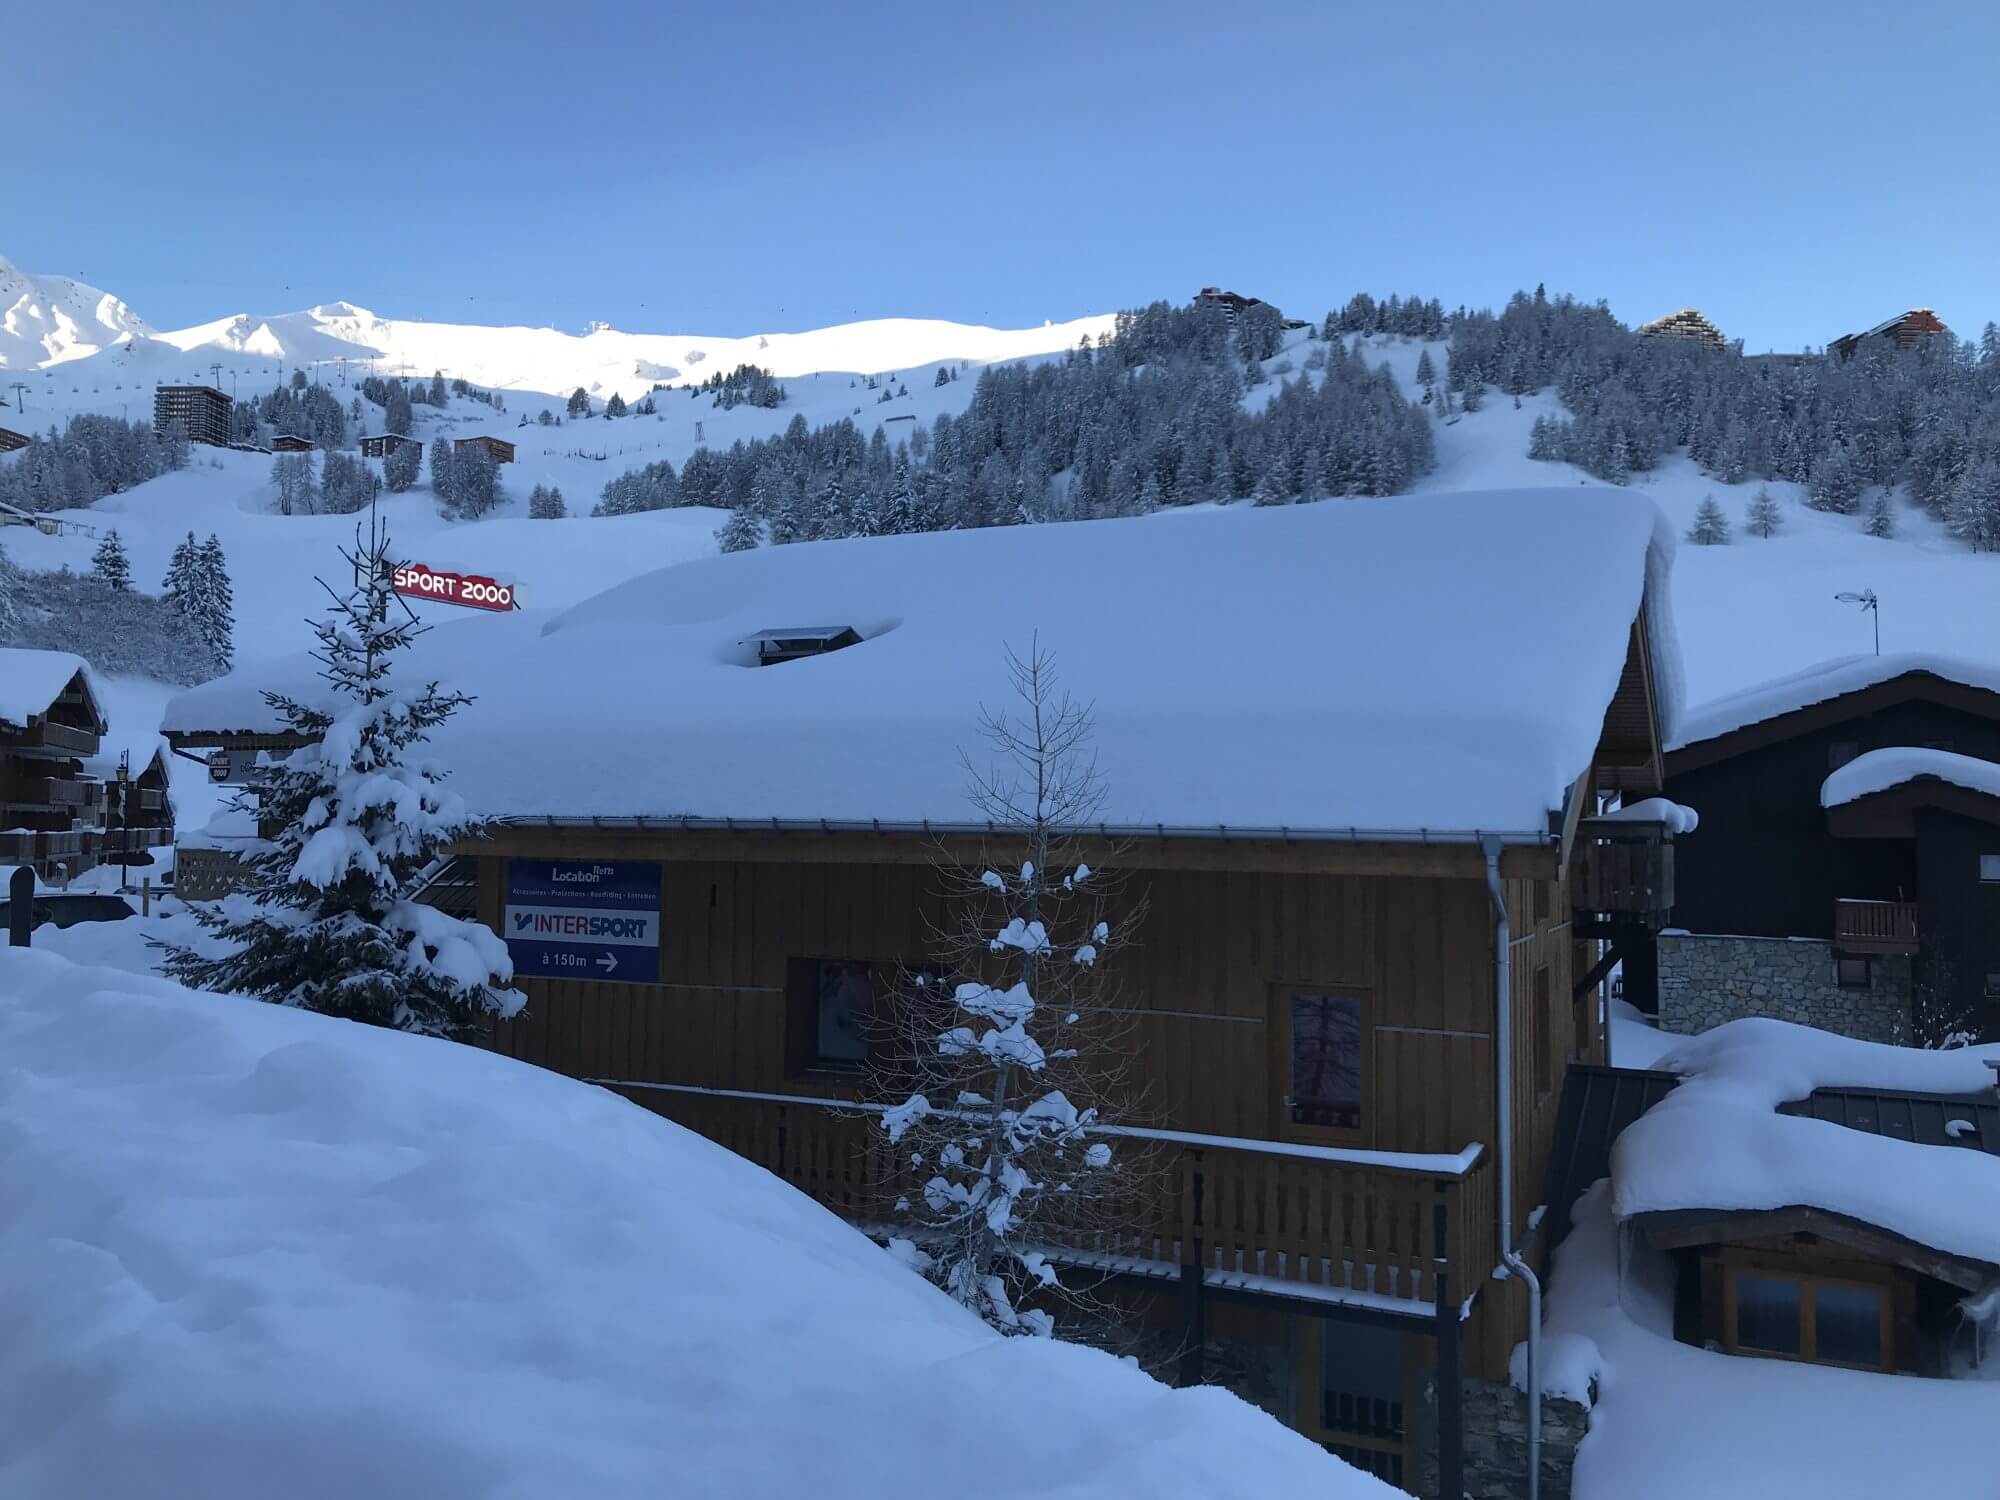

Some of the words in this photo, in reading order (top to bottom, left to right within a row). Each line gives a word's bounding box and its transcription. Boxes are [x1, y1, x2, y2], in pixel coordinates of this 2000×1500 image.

[393, 569, 457, 595] SPORT
[461, 581, 511, 605] 2000
[552, 867, 600, 883] Location
[534, 913, 647, 939] INTERSPORT
[542, 952, 550, 965] à
[554, 953, 587, 967] 150m
